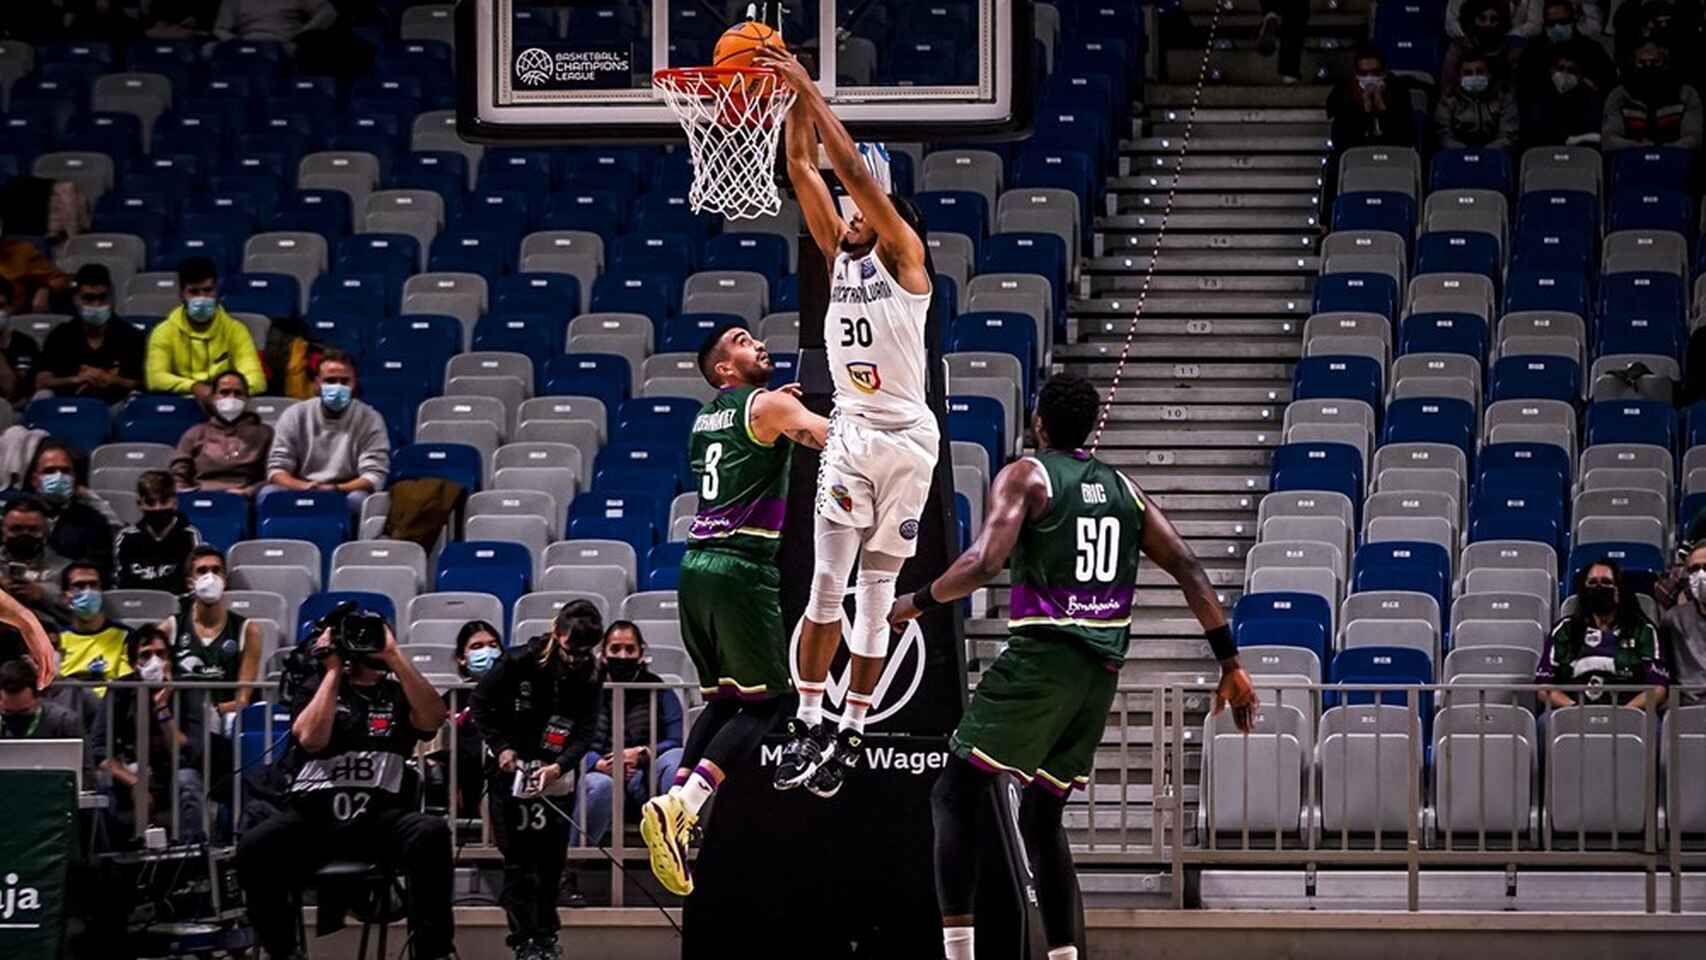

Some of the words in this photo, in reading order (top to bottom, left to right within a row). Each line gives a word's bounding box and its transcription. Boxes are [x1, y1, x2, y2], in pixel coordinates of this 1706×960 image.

[555, 52, 620, 61] BASKETBALL
[555, 61, 629, 71] CHAMPIONS
[555, 72, 594, 81] LEAGUE
[840, 317, 873, 347] 30
[1075, 516, 1121, 582] 50
[333, 792, 370, 820] 02
[0, 873, 41, 919] ja
